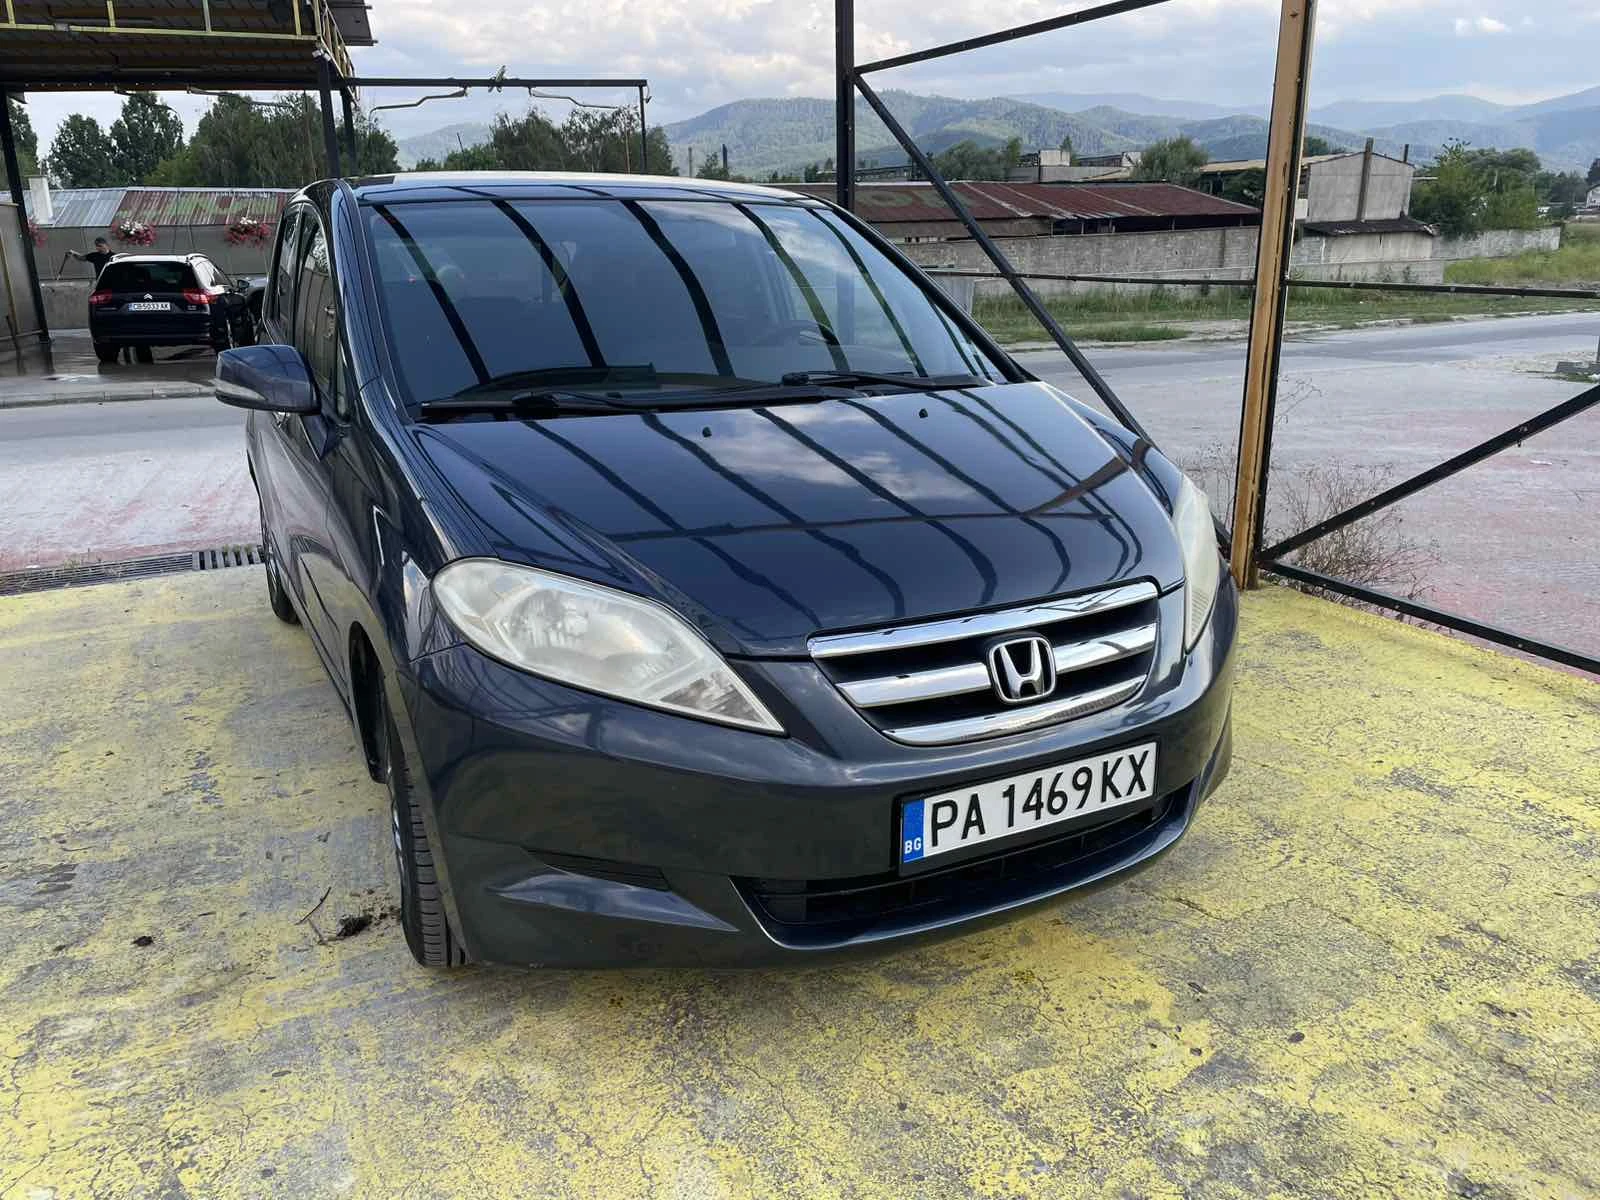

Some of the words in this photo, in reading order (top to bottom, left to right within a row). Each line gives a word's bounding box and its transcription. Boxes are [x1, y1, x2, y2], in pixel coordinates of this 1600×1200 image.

[931, 793, 986, 847] PA
[1002, 766, 1092, 828] 1469
[1101, 750, 1148, 802] KX
[904, 837, 922, 854] BG
